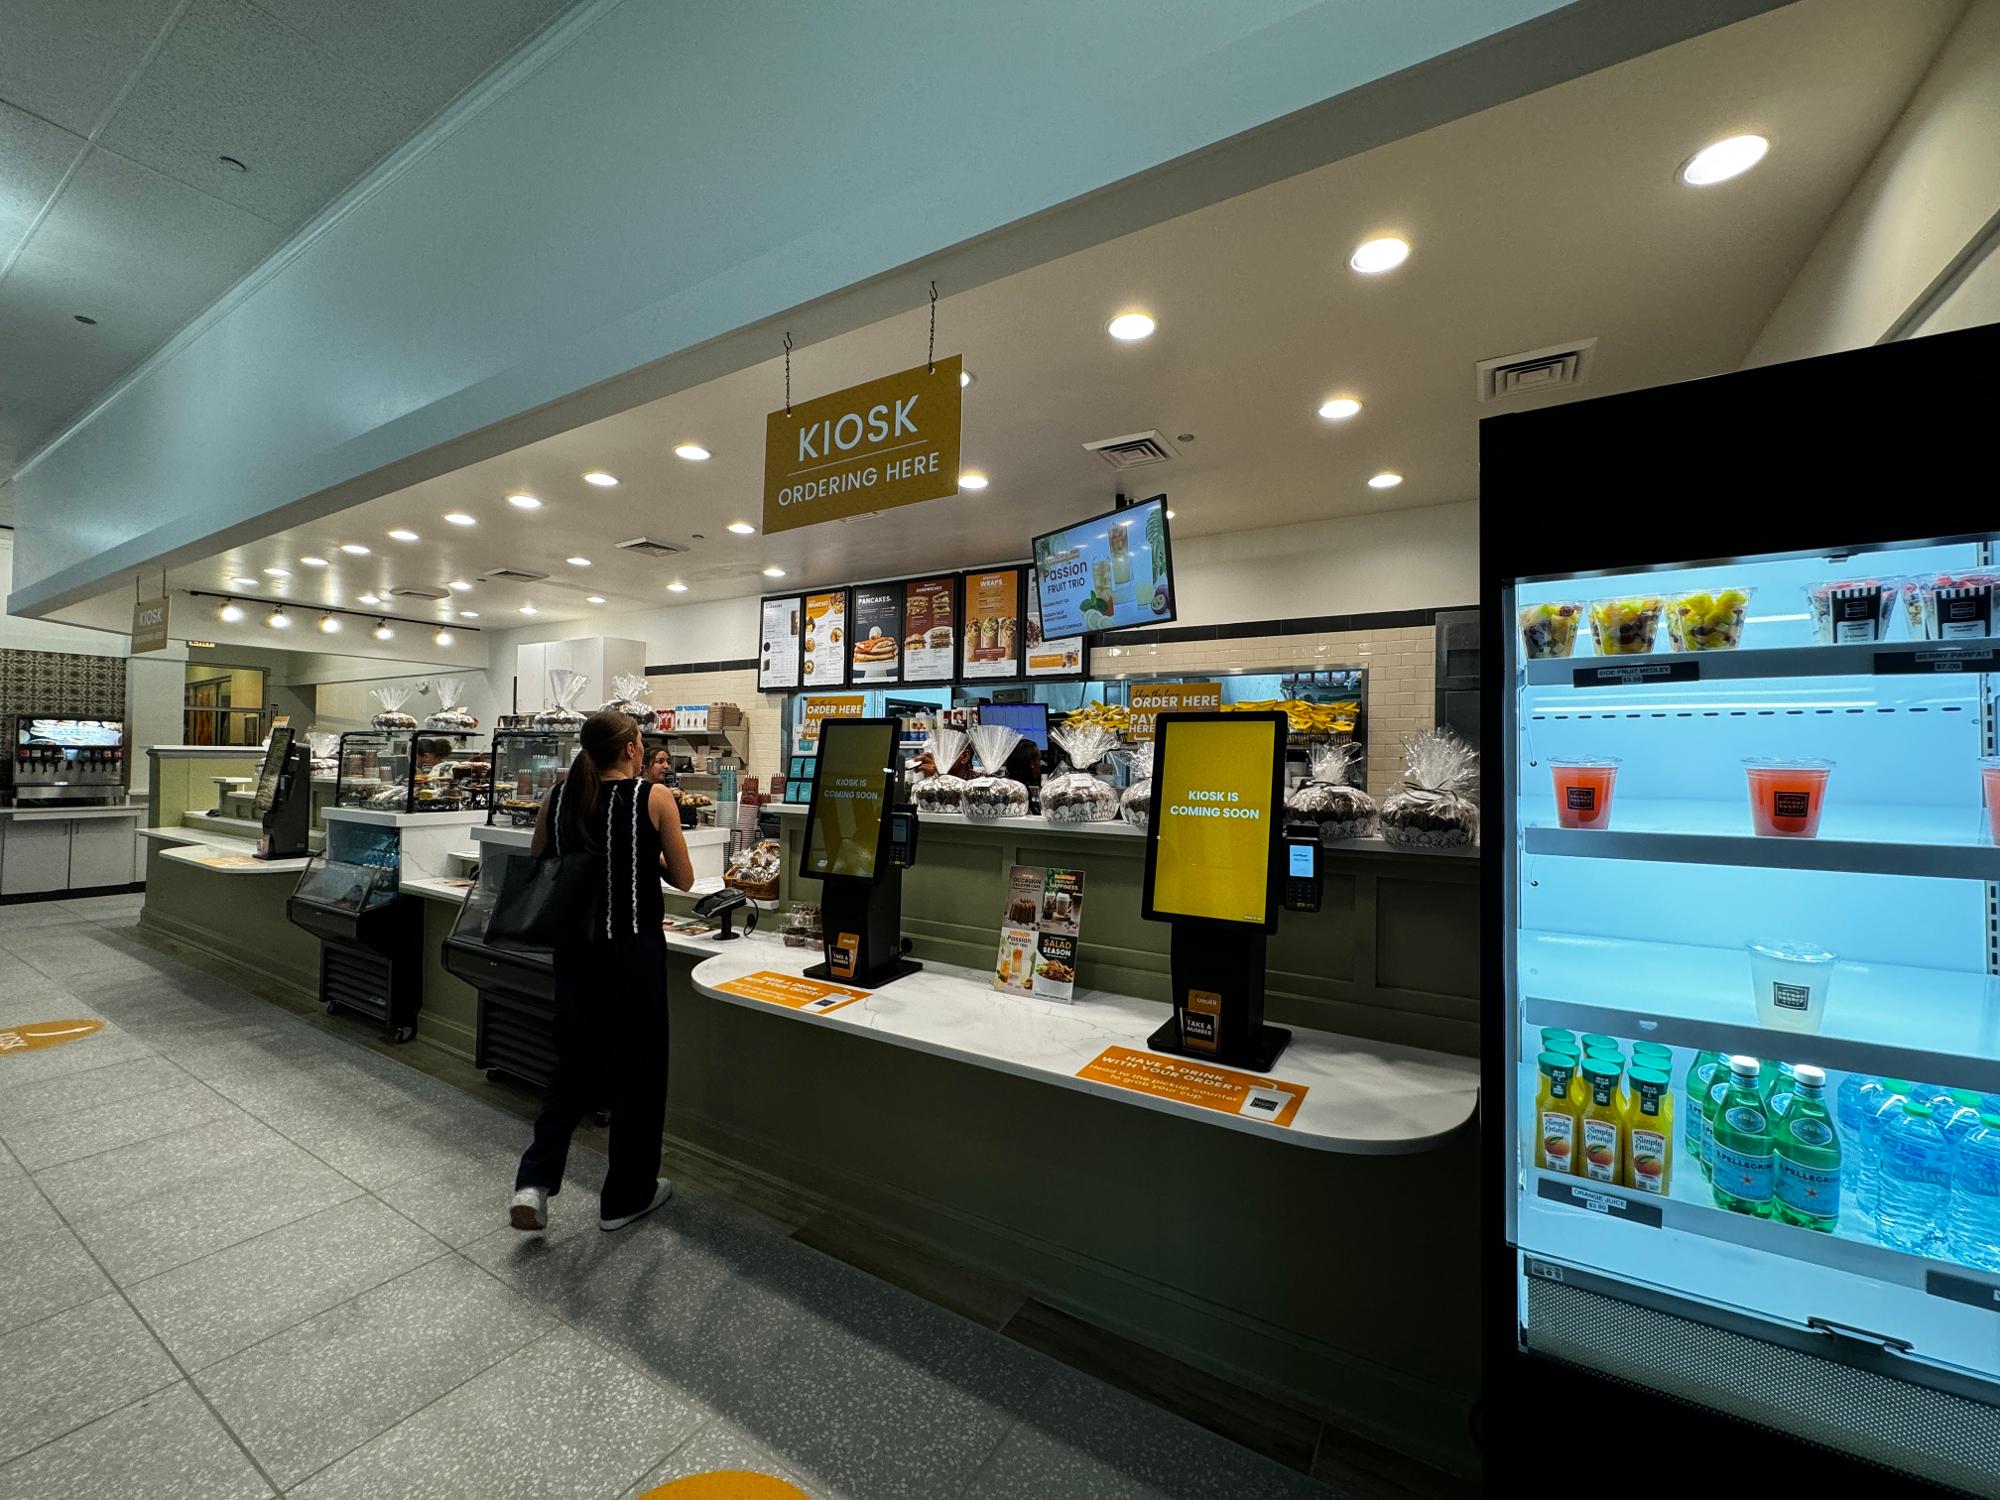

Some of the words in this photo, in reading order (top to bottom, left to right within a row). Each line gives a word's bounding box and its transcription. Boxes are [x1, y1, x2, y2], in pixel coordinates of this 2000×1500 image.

[798, 394, 920, 462] KIOSK
[778, 467, 877, 507] ORDERING
[886, 452, 940, 482] HERE
[1043, 561, 1088, 583] Passion
[980, 579, 1002, 587] WRAPS
[1047, 581, 1066, 594] FRUIT
[1068, 577, 1085, 589] TRIO
[858, 596, 890, 604] PANCAKES
[139, 607, 162, 626] KIOSK
[1950, 650, 1991, 658] PARFAIT
[1640, 666, 1670, 674] MEDLEY
[1132, 696, 1178, 708] ORDER
[1182, 694, 1219, 707] HERE
[807, 705, 836, 714] ORDER
[838, 704, 862, 714] HERE
[805, 718, 822, 728] PAY
[1130, 713, 1157, 724] PAY
[1129, 724, 1155, 733] HERE
[835, 778, 859, 787] KIOSK
[859, 778, 867, 787] IS
[824, 790, 855, 799] COMING
[855, 791, 878, 800] SOON
[1188, 790, 1225, 802] KIOSK
[1228, 792, 1239, 802] IS
[1170, 805, 1220, 817] COMING
[1223, 808, 1260, 819] SOON
[1044, 938, 1072, 949] SALAD
[1042, 947, 1071, 957] SEASON
[1187, 1020, 1205, 1029] TAKE
[1186, 1026, 1212, 1036] NUMBER
[1102, 1056, 1137, 1068] WITH
[1142, 1065, 1180, 1078] YOUR
[1183, 1075, 1242, 1091] ORDER?
[1125, 1056, 1162, 1067] HAVE
[1179, 1068, 1225, 1081] DRINK
[1089, 1064, 1117, 1074] Head
[1132, 1074, 1150, 1082] the
[1152, 1079, 1190, 1091] pickup
[1192, 1088, 1239, 1102] counter
[1122, 1077, 1149, 1087] grab
[1152, 1084, 1178, 1093] your
[1545, 1117, 1570, 1129] Simply
[1586, 1125, 1613, 1138] Simply
[1586, 1133, 1613, 1145] Orange
[1635, 1136, 1663, 1149] Simply
[1634, 1143, 1662, 1156] Orange
[1573, 1188, 1604, 1202] ORANGE
[1604, 1197, 1625, 1207] JUICE
